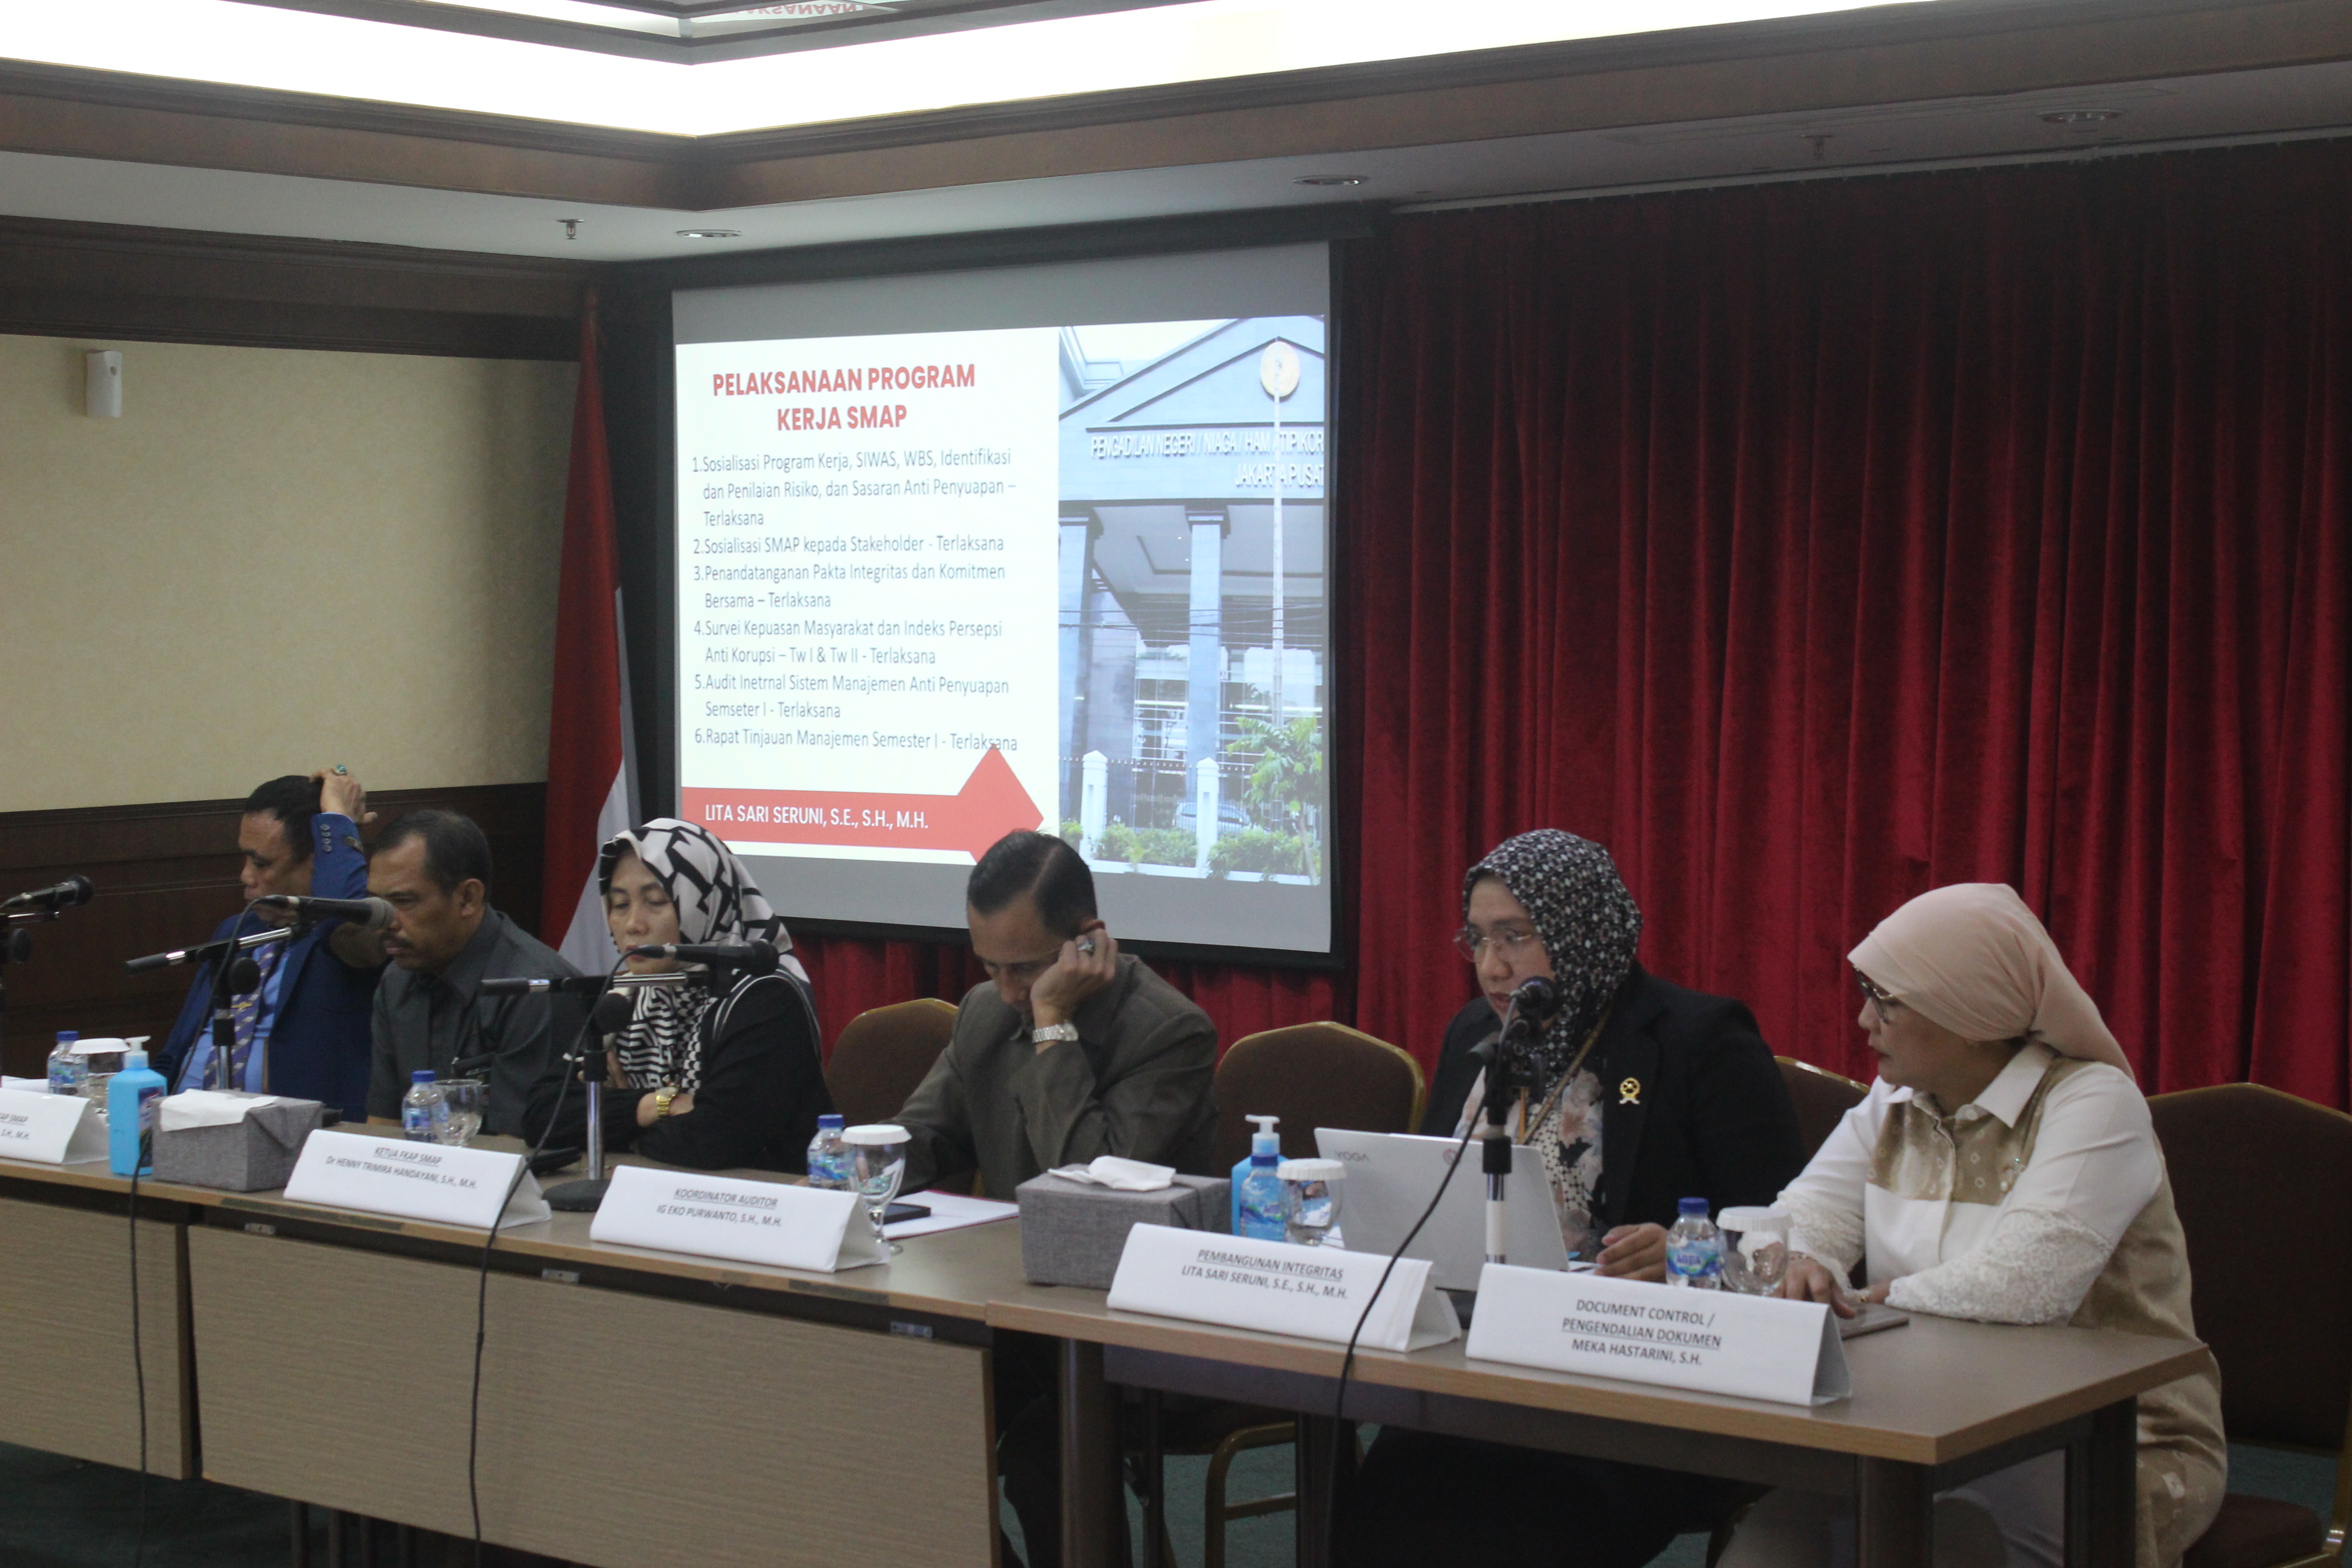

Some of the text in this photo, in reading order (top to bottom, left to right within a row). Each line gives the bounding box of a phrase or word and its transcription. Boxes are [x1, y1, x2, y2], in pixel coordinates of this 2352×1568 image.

[712, 363, 974, 396] PELAKSANAAN PROGRAM
[777, 405, 906, 430] KERJA SMAP
[1092, 433, 1154, 458] PENGADILAN
[1156, 432, 1196, 456] NEGERI
[1203, 431, 1238, 455] NIAGA
[1245, 431, 1271, 454] HAM
[763, 454, 813, 472] Program
[818, 452, 852, 471] Kerja,
[856, 451, 899, 468] SIWAS,
[903, 450, 936, 467] WBS,
[941, 447, 1010, 465] Identifikasi
[703, 483, 723, 498] dan
[727, 482, 779, 497] Penilaian
[784, 480, 821, 498] Risiko,
[826, 480, 848, 495] dan
[852, 480, 900, 495] Sasaran
[903, 479, 929, 494] Anti
[933, 478, 1003, 497] Penyuapan
[703, 510, 763, 525] Terlaksana
[764, 537, 799, 552] SMAP
[804, 535, 846, 554] kepada
[850, 535, 924, 551] Stakeholder
[936, 534, 1003, 550] Terlaksana
[813, 563, 845, 578] Pakta
[850, 564, 907, 583] Integritas
[911, 563, 935, 578] dan
[939, 564, 1004, 578] Komitmen
[705, 593, 753, 607] Bersama
[767, 591, 830, 607] Terlaksana
[744, 620, 799, 637] Kepuasan
[804, 619, 873, 638] Masyarakat
[877, 619, 899, 635] dan
[904, 619, 944, 635] Indeks
[949, 620, 1001, 639] Persepsi
[705, 647, 728, 662] Anti
[731, 647, 774, 665] Korupsi
[789, 647, 805, 662] Tw
[809, 647, 812, 662] I
[817, 646, 826, 662] &
[829, 647, 847, 662] Tw
[851, 647, 858, 662] II
[869, 647, 935, 663] Terlaksana
[740, 674, 785, 689] Inetrnal
[789, 675, 828, 689] Sistem
[832, 675, 905, 694] Manajemen
[909, 676, 935, 691] Anti
[939, 676, 1008, 696] Penyuapan
[706, 701, 759, 716] Semseter
[763, 701, 766, 715] I
[777, 701, 840, 717] Terlaksana
[742, 728, 792, 747] Tinjauan
[797, 730, 868, 748] Manajemen
[872, 731, 930, 747] Semester
[934, 733, 937, 747] I
[950, 733, 1017, 751] Terlaksana
[706, 804, 928, 829] LITA SARI SERUNI, S.E., S.H., M.H.
[675, 1188, 778, 1207] KOORDINATOR AUDITOR
[657, 1205, 781, 1226] IG EKO PURWANTO, S.H., M.H.
[1197, 1249, 1344, 1279] PEMBANGUNAN INTEGRITAS
[1181, 1265, 1348, 1299] LITA SARI SERUNI, S.E., S.H., M.H.
[1576, 1299, 1646, 1318] DOCUMENT
[1648, 1307, 1705, 1325] CONTROL
[1563, 1318, 1721, 1347] PENGENDALIAN DOKUMEN
[1572, 1338, 1702, 1366] MEKA HASTARINI, S.H.
